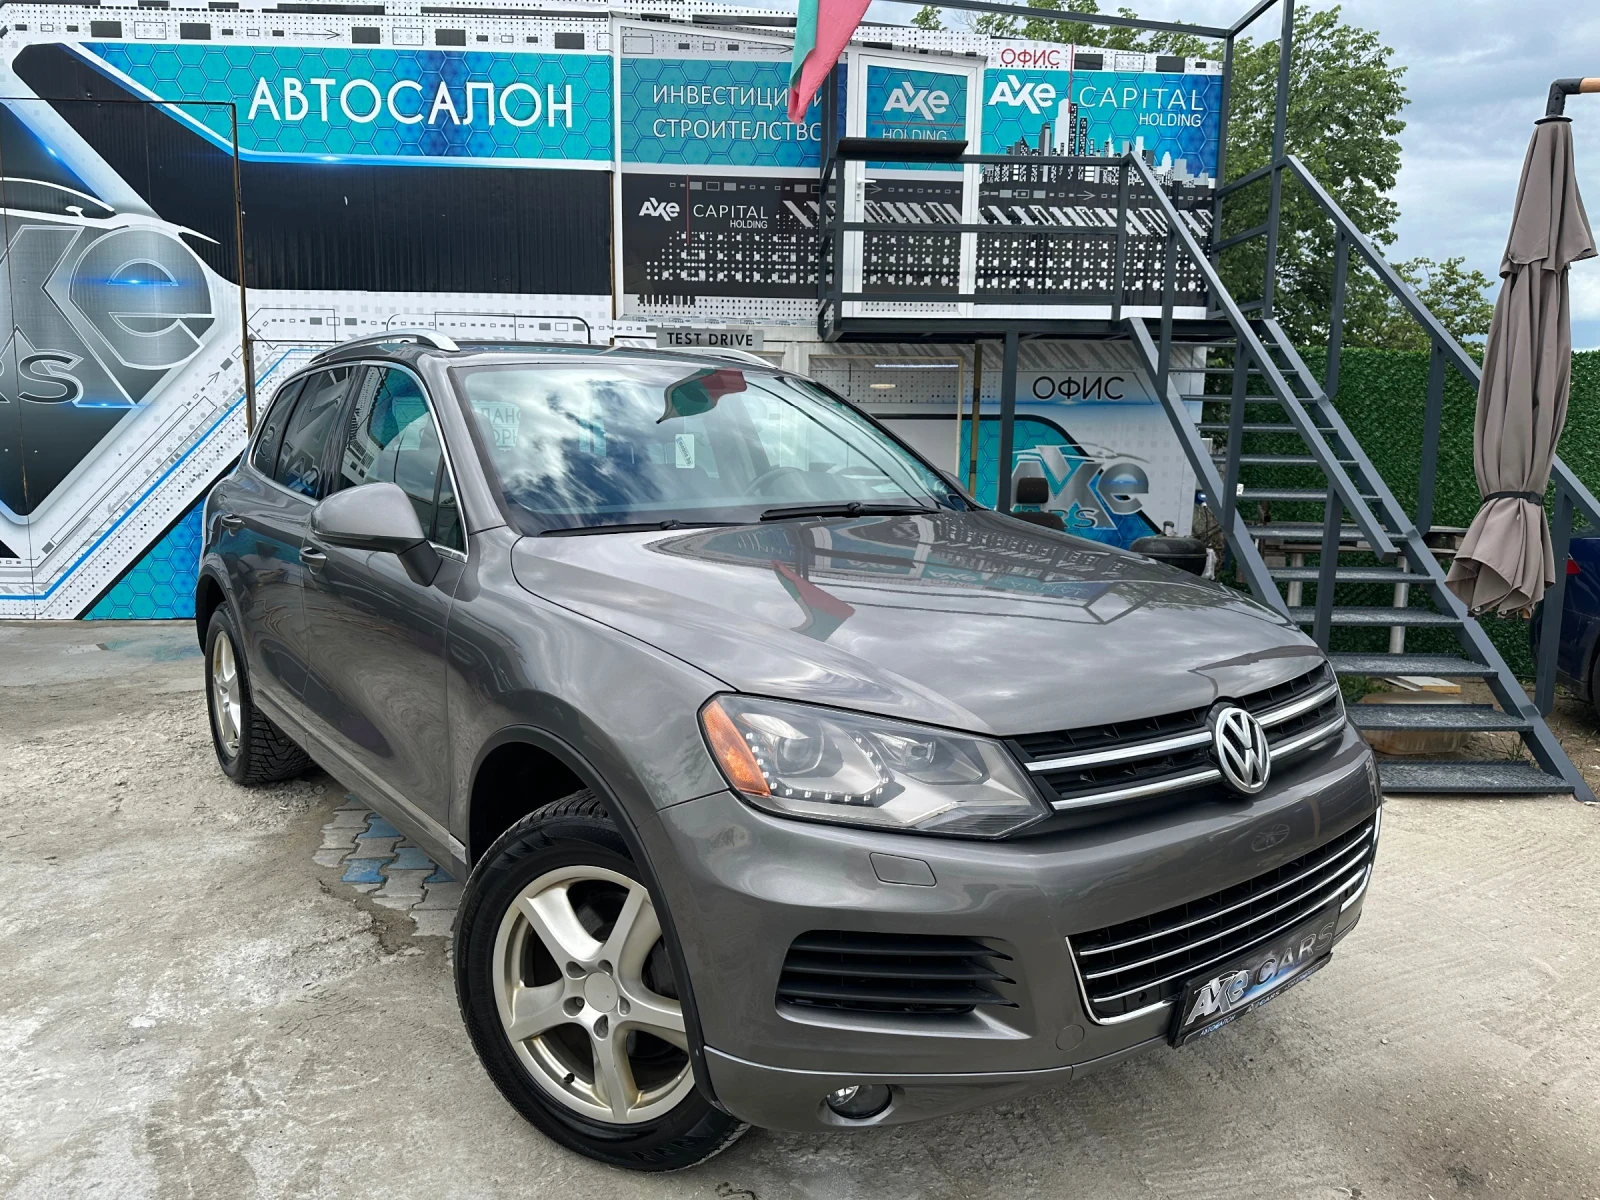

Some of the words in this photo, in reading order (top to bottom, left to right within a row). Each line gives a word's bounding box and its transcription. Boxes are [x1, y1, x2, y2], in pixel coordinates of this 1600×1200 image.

[1001, 48, 1061, 67] ОФИС
[247, 76, 573, 128] АВТОСАЛОН
[652, 84, 789, 111] ИНВЕСТИЦИ
[1079, 86, 1204, 111] CAPITAL
[1139, 112, 1202, 127] HOLDING
[693, 204, 769, 220] CAPITAL
[729, 219, 769, 229] HOLDING
[666, 332, 702, 345] TEST
[708, 333, 754, 347] DRIVE
[1032, 376, 1125, 400] ОФИС
[1254, 921, 1335, 987] CARS
